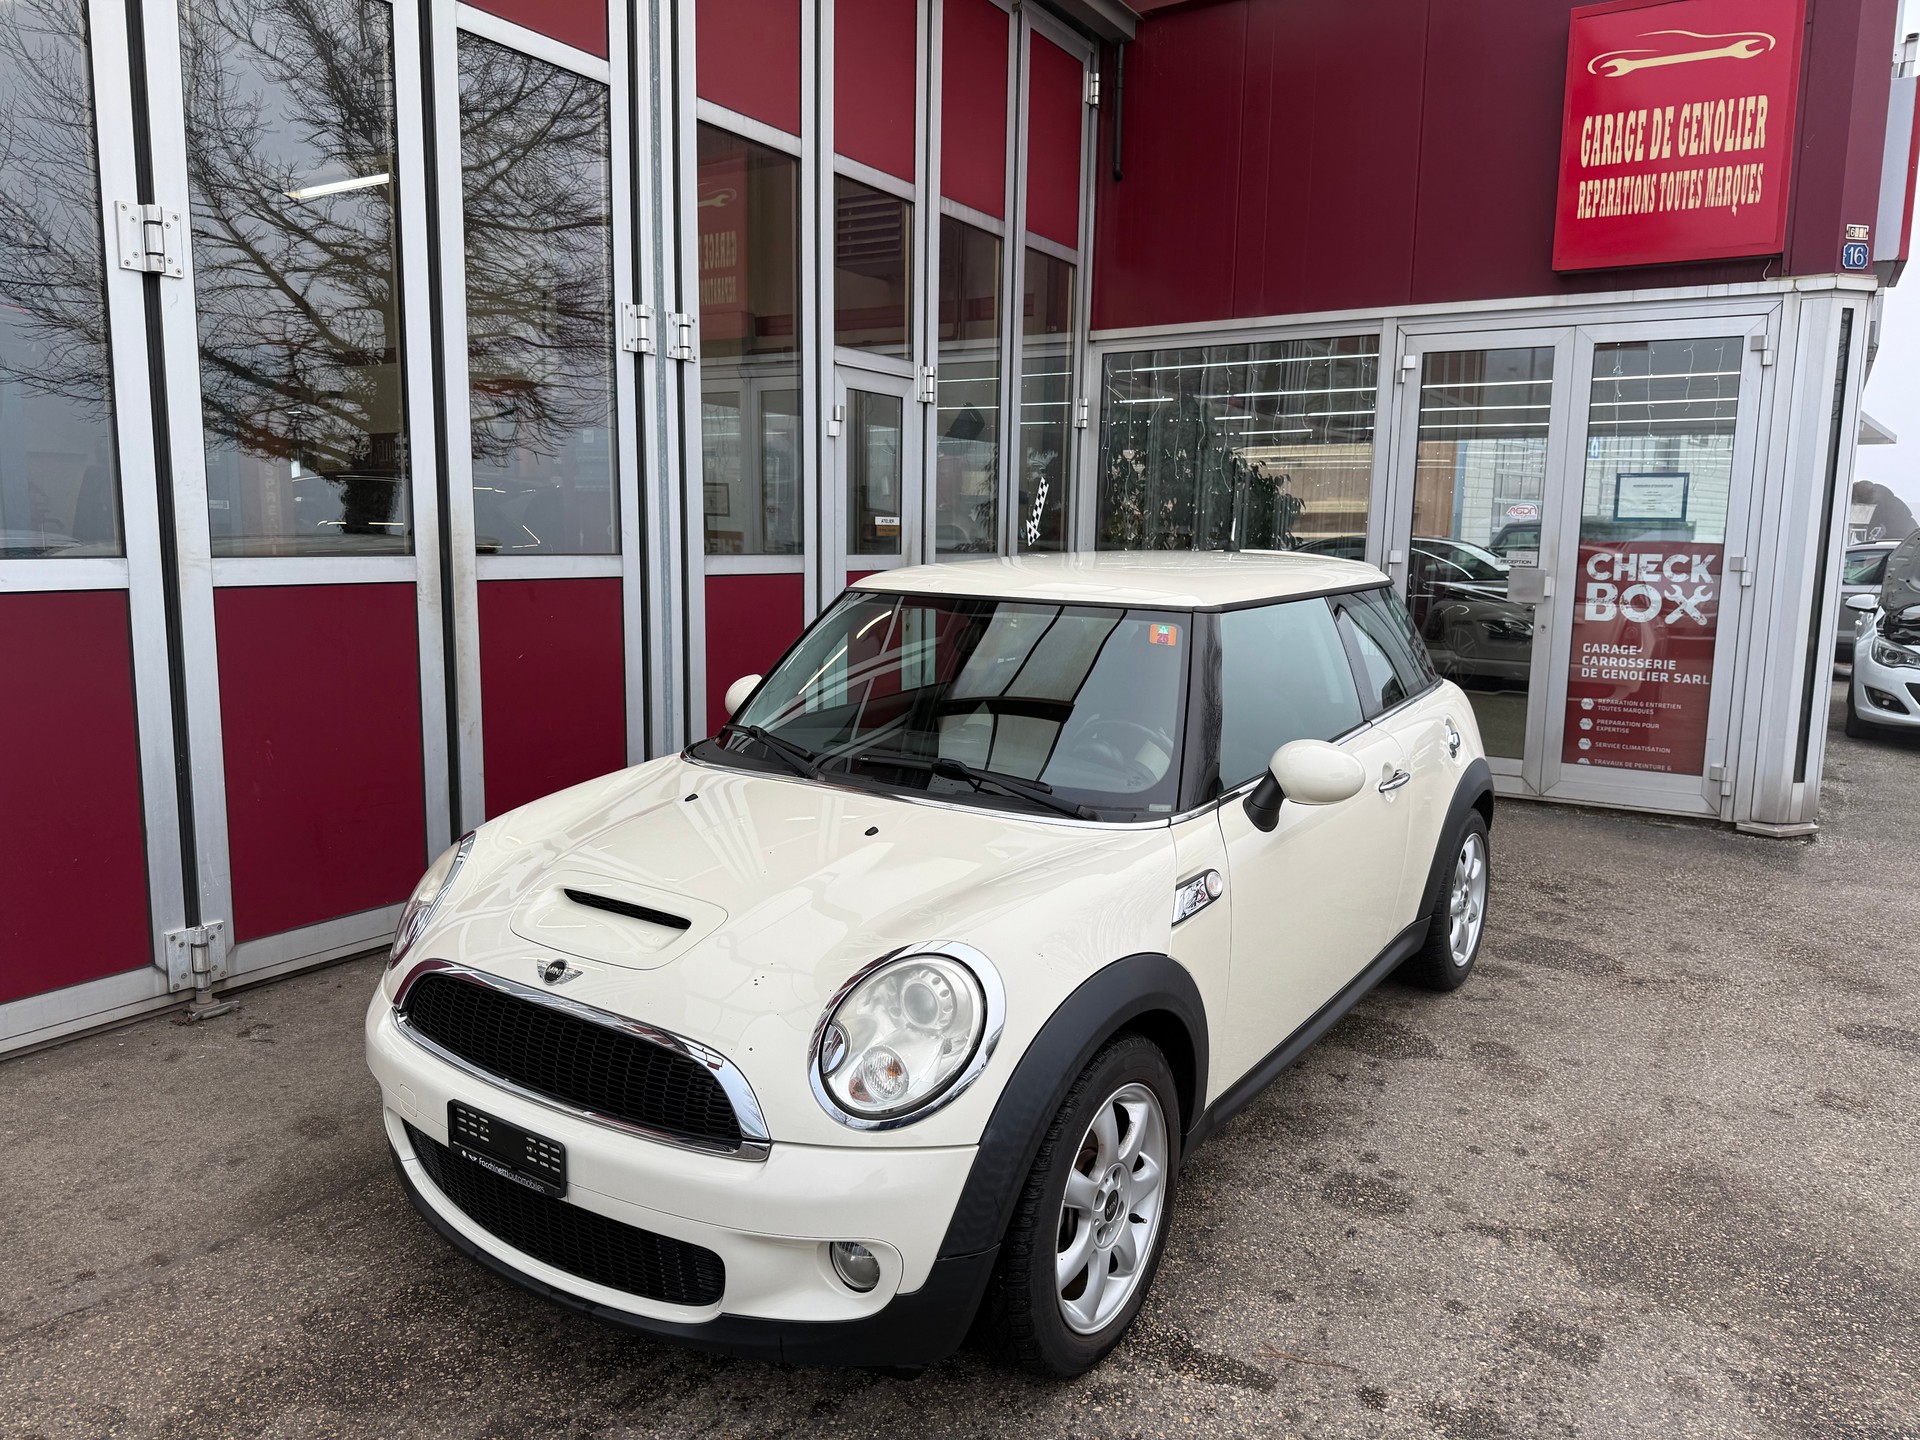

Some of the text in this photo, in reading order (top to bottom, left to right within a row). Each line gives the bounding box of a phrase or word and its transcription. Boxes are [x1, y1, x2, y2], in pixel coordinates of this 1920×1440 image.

[1580, 95, 1768, 168] GARAGE DE GENOLIER
[1577, 163, 1764, 219] REPARATIONS TOUTES MARQUES
[1848, 246, 1864, 265] 16
[1586, 553, 1717, 583] CHECK
[1585, 583, 1713, 626] BOX
[1583, 643, 1637, 655] GARAGE
[1582, 656, 1676, 670] CARROSSERIE
[1581, 668, 1710, 685] DE GENOLIER SARL
[1623, 707, 1654, 715] MARQUES
[1646, 702, 1682, 710] ENTRETIEN
[1596, 726, 1630, 734] EXPERTISE
[1595, 741, 1671, 754] SERVICE CLIMATISATION
[1594, 758, 1624, 767] TRAVAUX
[1634, 762, 1665, 771] PEINTURE
